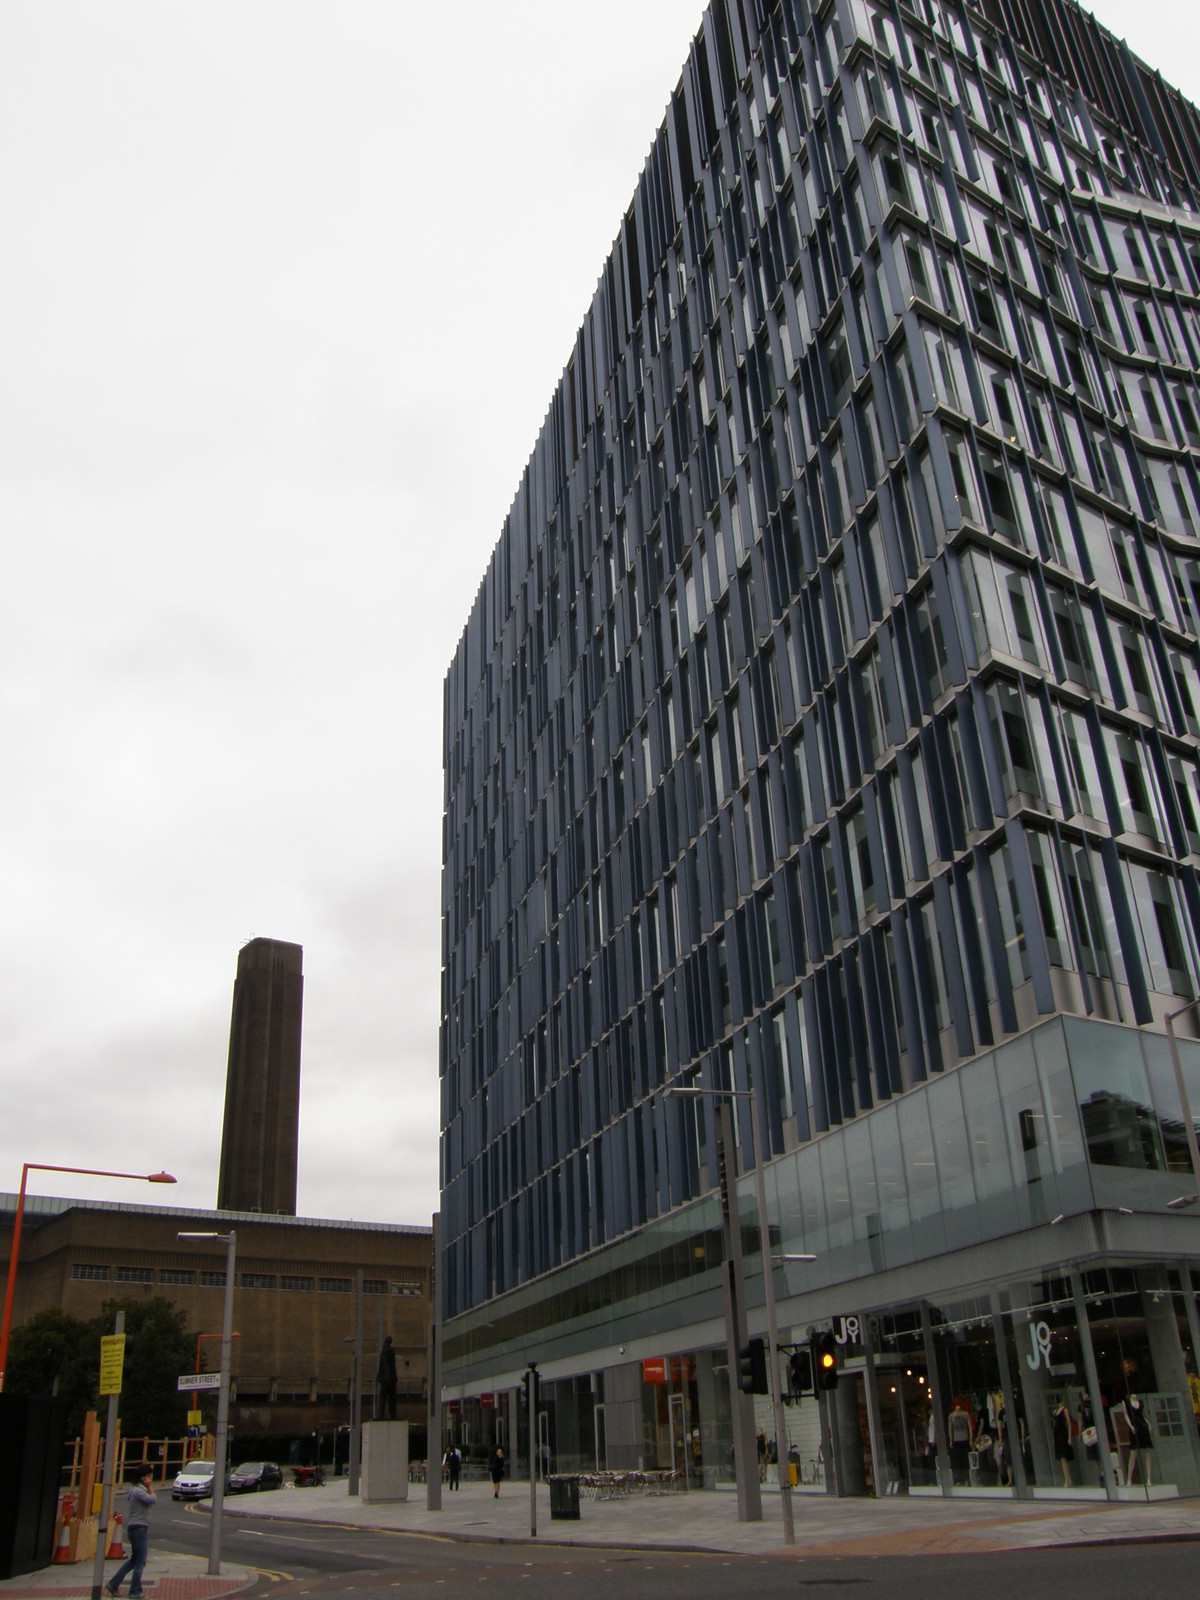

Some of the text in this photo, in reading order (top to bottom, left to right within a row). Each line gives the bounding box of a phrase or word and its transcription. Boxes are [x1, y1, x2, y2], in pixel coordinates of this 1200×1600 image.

[835, 1317, 859, 1344] JOY
[1026, 1321, 1052, 1370] JOY
[199, 1375, 216, 1384] STREET
